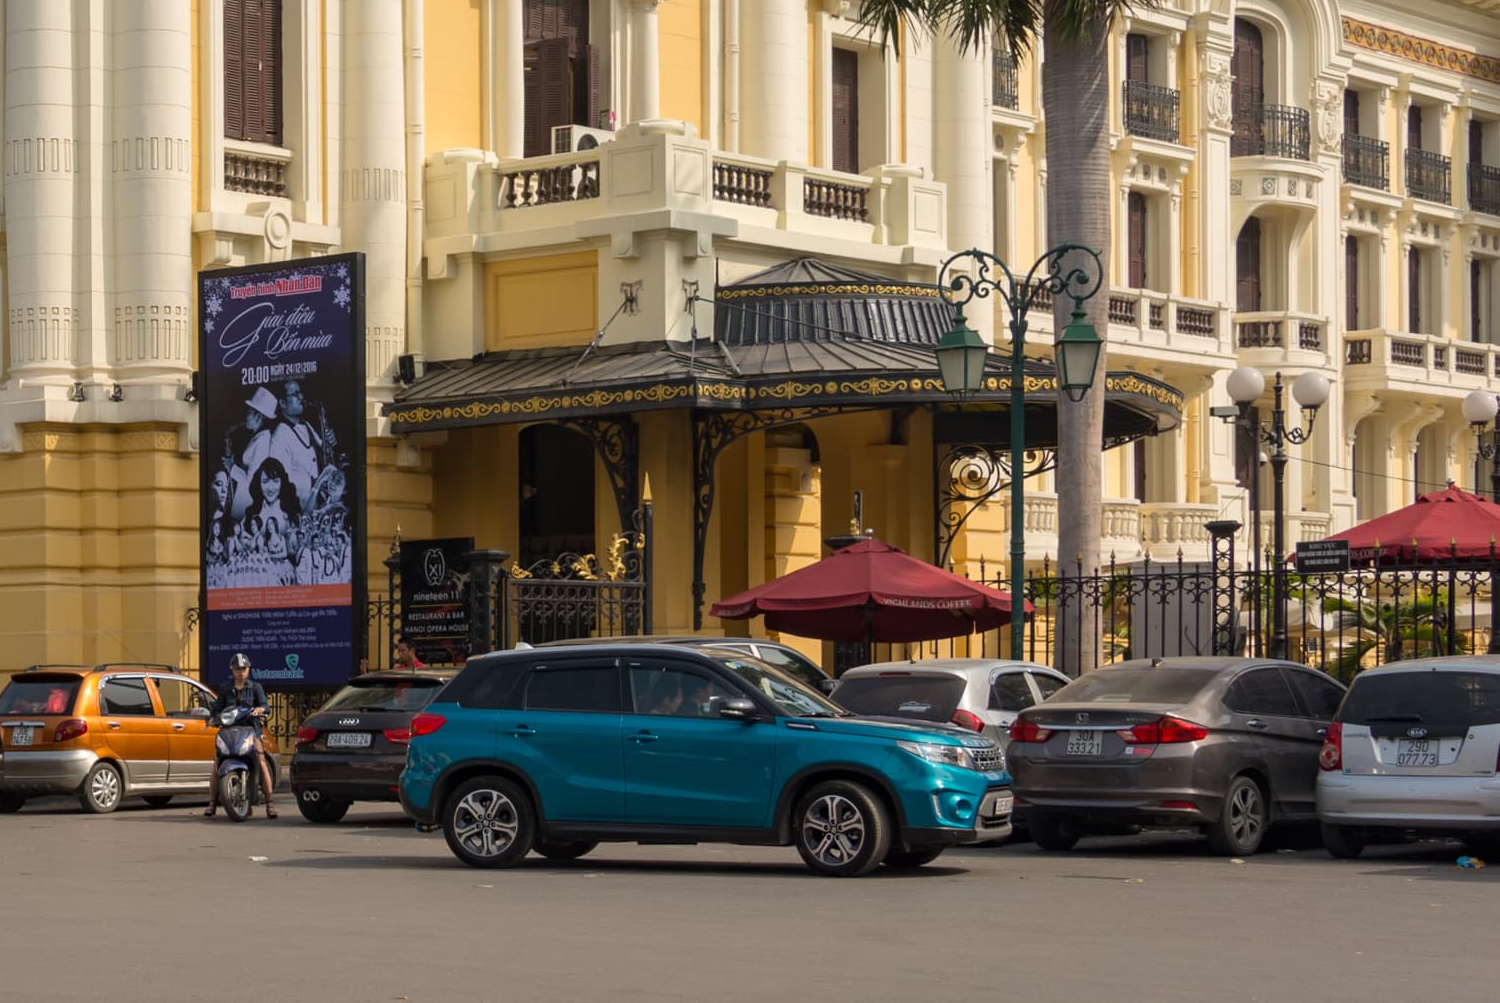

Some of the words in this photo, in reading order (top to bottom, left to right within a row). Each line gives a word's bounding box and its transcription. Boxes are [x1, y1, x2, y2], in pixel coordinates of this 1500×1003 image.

[413, 591, 448, 601] nineteen
[937, 599, 972, 609] COFFEE
[408, 611, 445, 621] RESTAURANT
[452, 610, 465, 619] BAR
[404, 625, 426, 634] HANOI
[426, 624, 447, 633] OPERA
[448, 623, 469, 632] HOUSE
[1076, 731, 1094, 742] 30A
[1407, 740, 1429, 752] 29D
